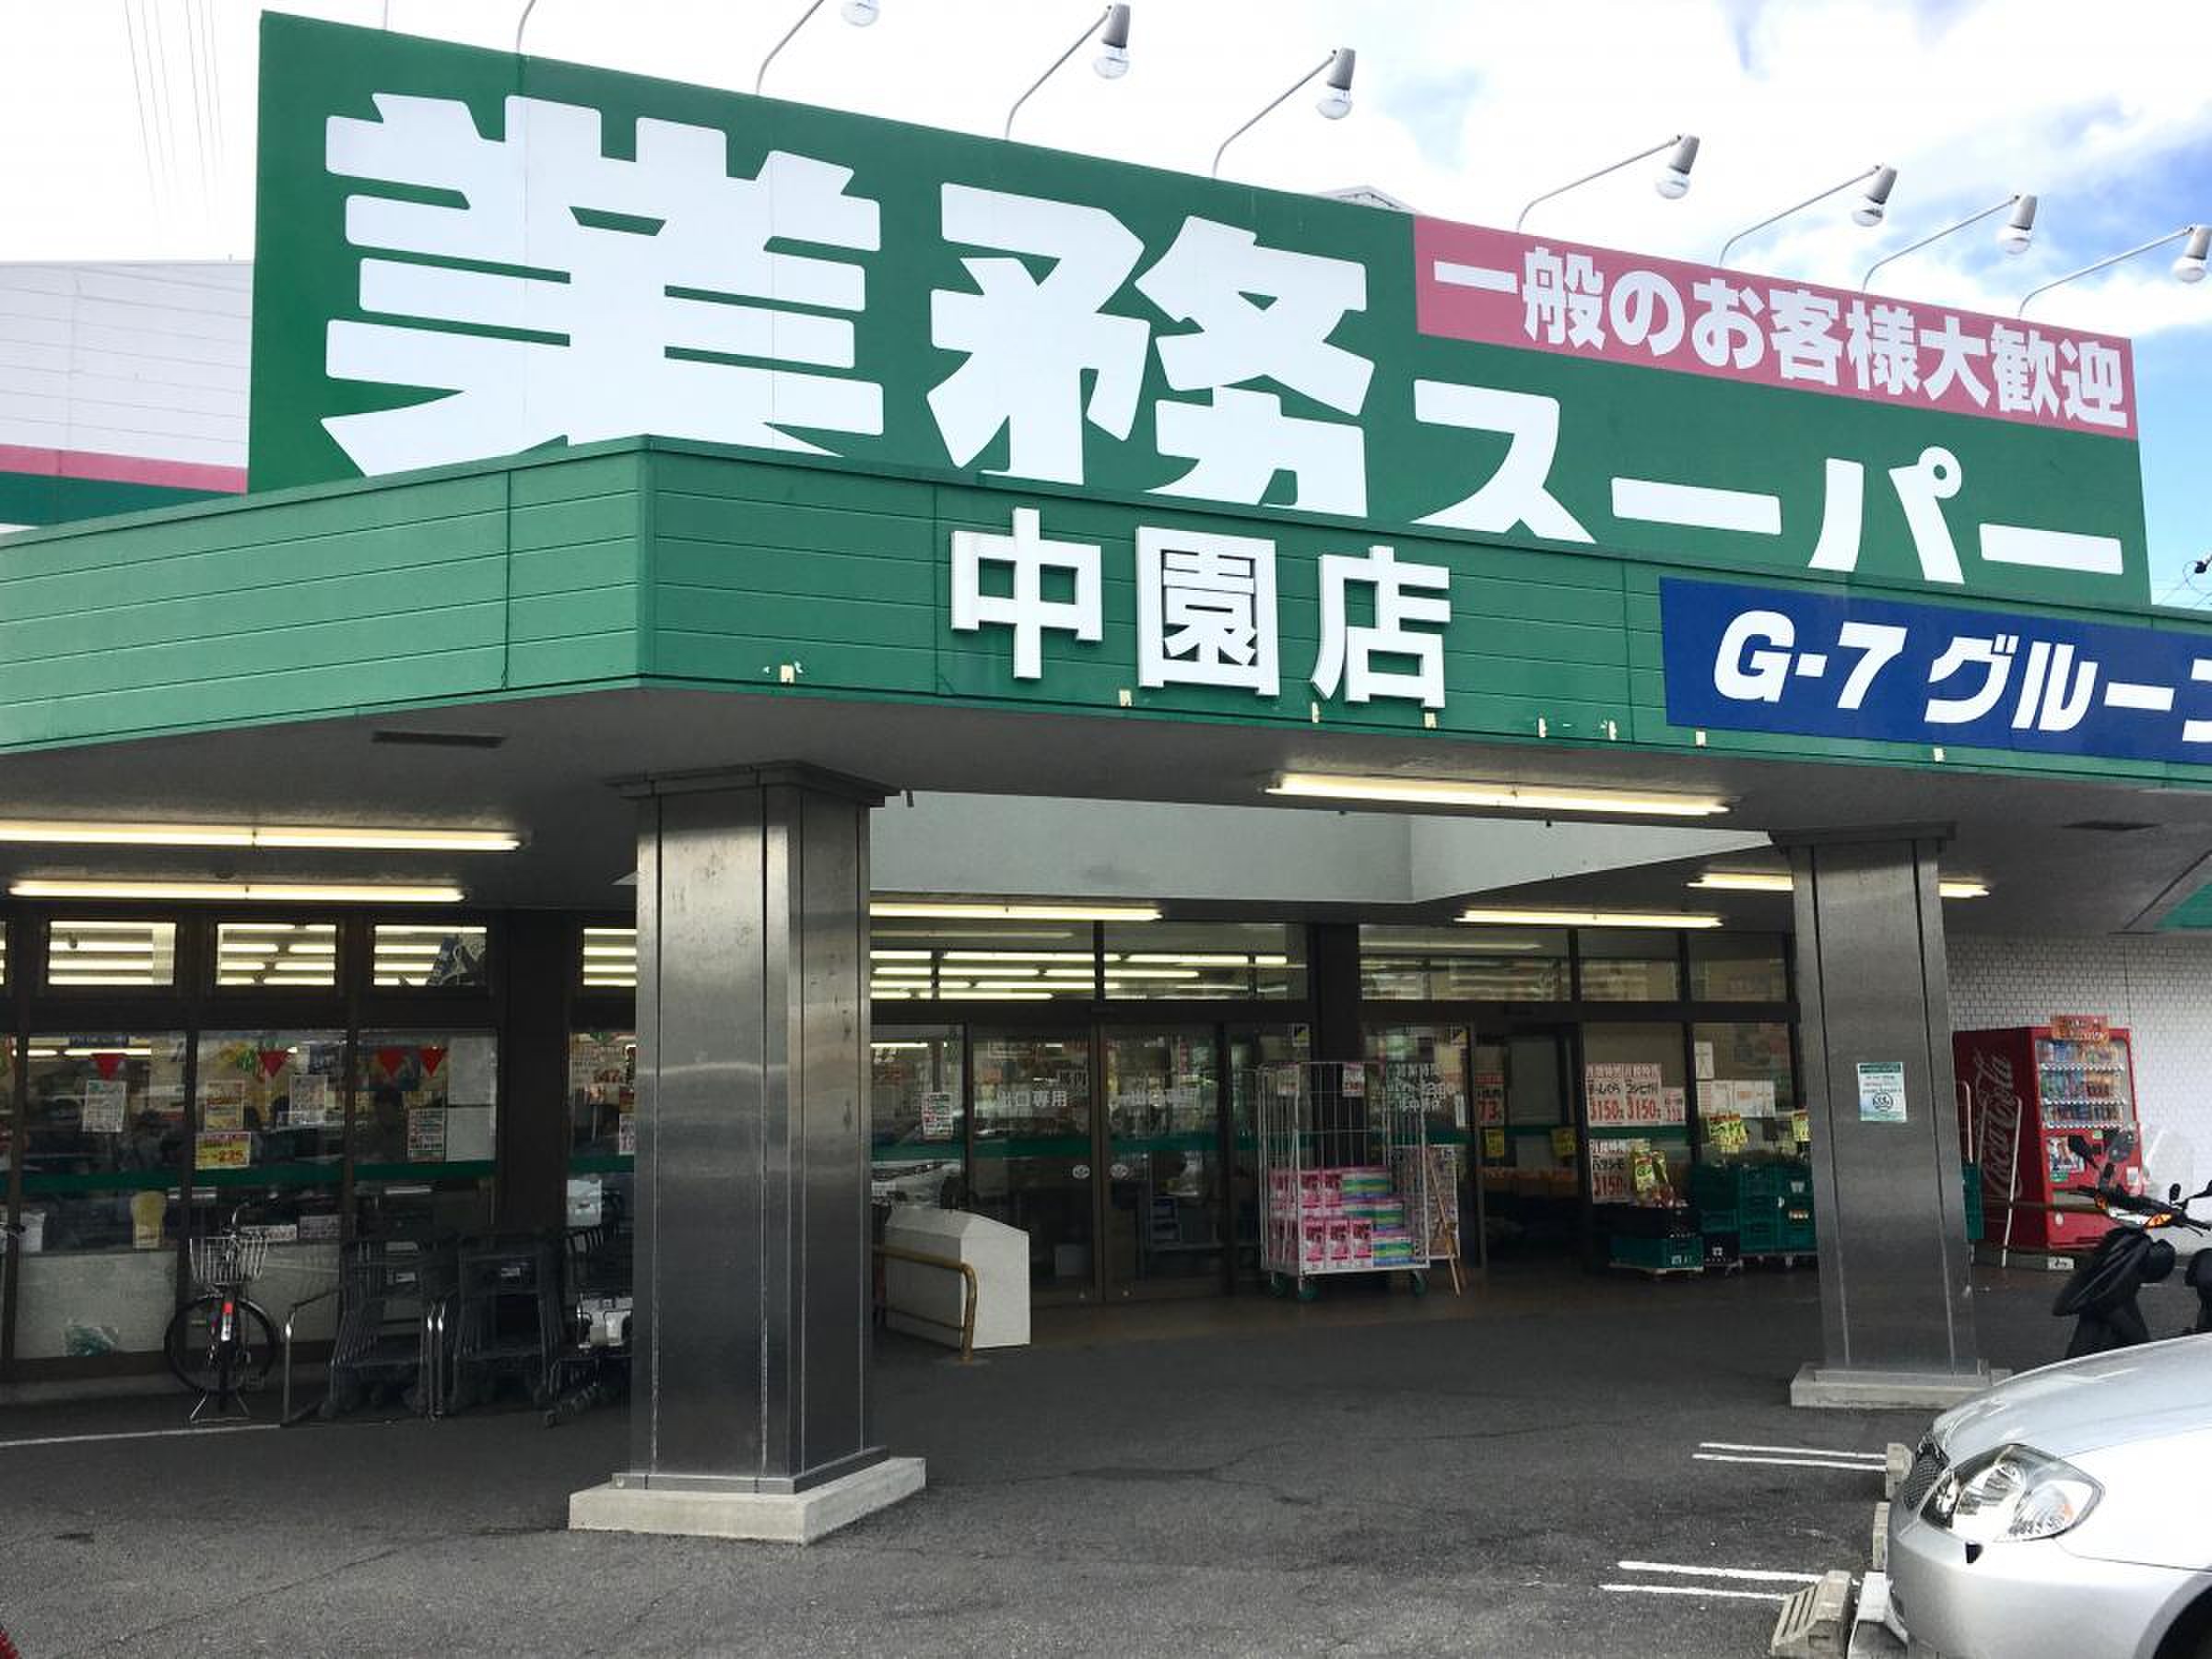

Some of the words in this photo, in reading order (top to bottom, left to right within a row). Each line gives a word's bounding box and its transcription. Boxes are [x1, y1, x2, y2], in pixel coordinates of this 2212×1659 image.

[322, 94, 2124, 584] 業務スーパー
[1433, 245, 2127, 429] 一般のお客様大歓迎
[950, 507, 1452, 710] 中園店
[1713, 610, 1907, 709] G-7
